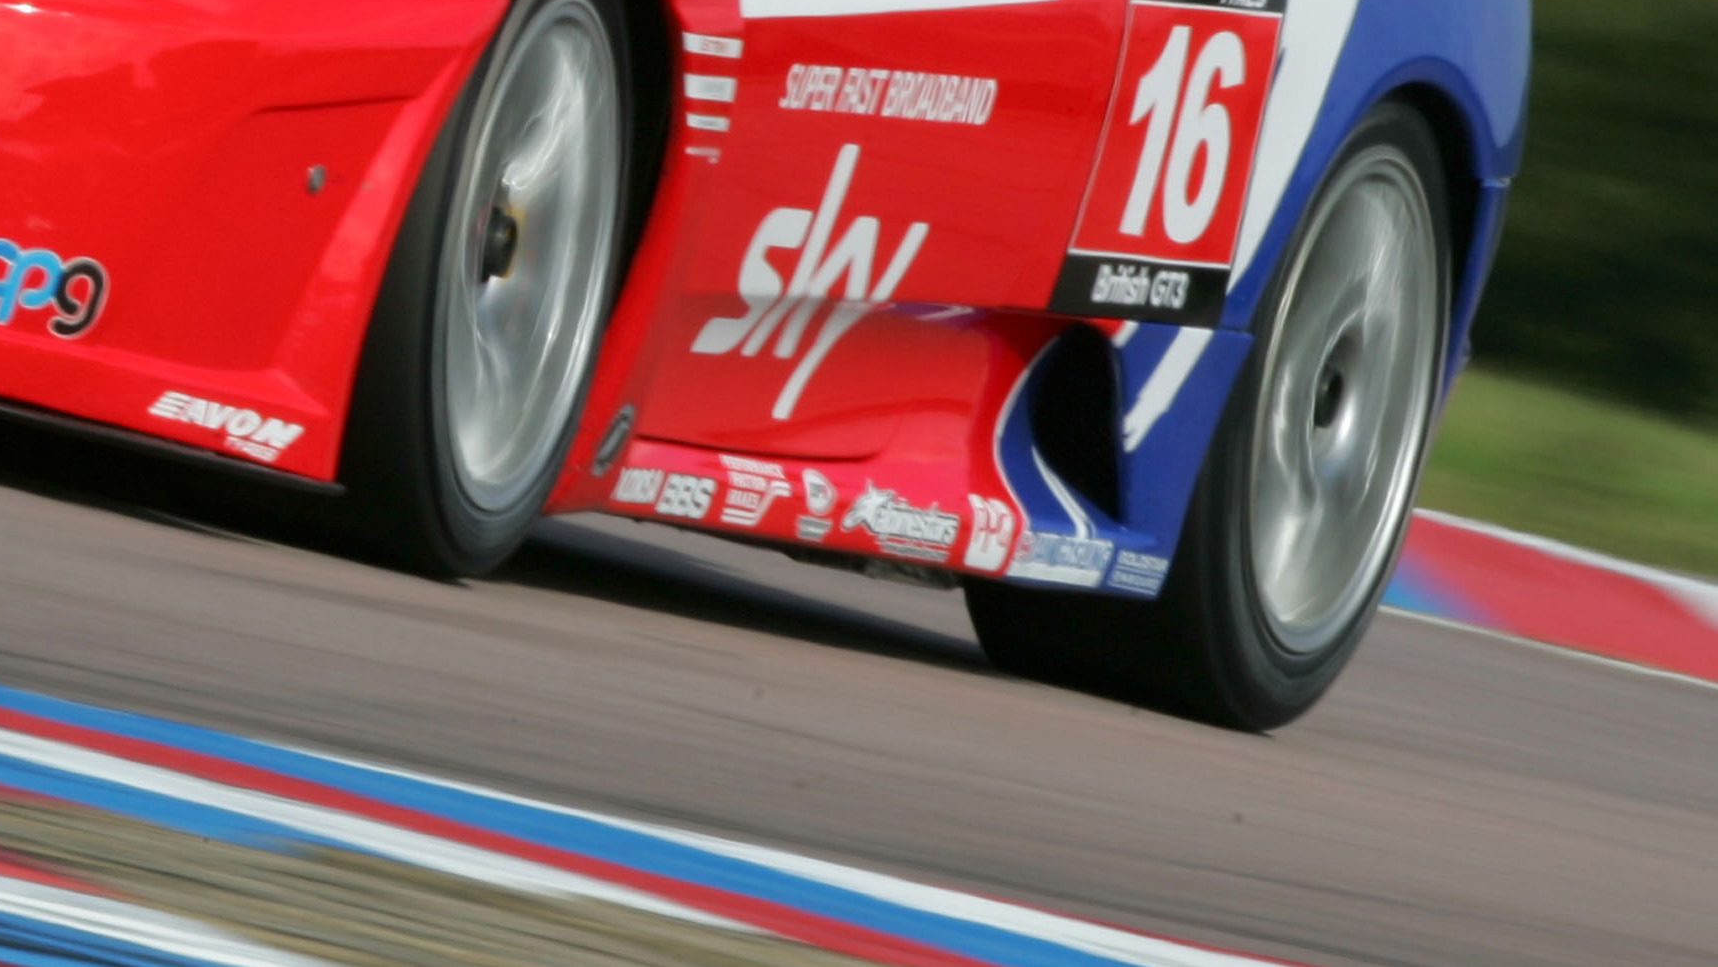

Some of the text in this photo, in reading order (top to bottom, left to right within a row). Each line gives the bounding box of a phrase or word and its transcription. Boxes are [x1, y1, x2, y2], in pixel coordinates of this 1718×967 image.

[778, 63, 999, 126] SUPER FAST BROADBAND
[1118, 24, 1247, 246] 16
[689, 143, 930, 420] sky
[1090, 263, 1190, 310] British GT3
[182, 396, 306, 450] AVON
[655, 472, 719, 521] BBS
